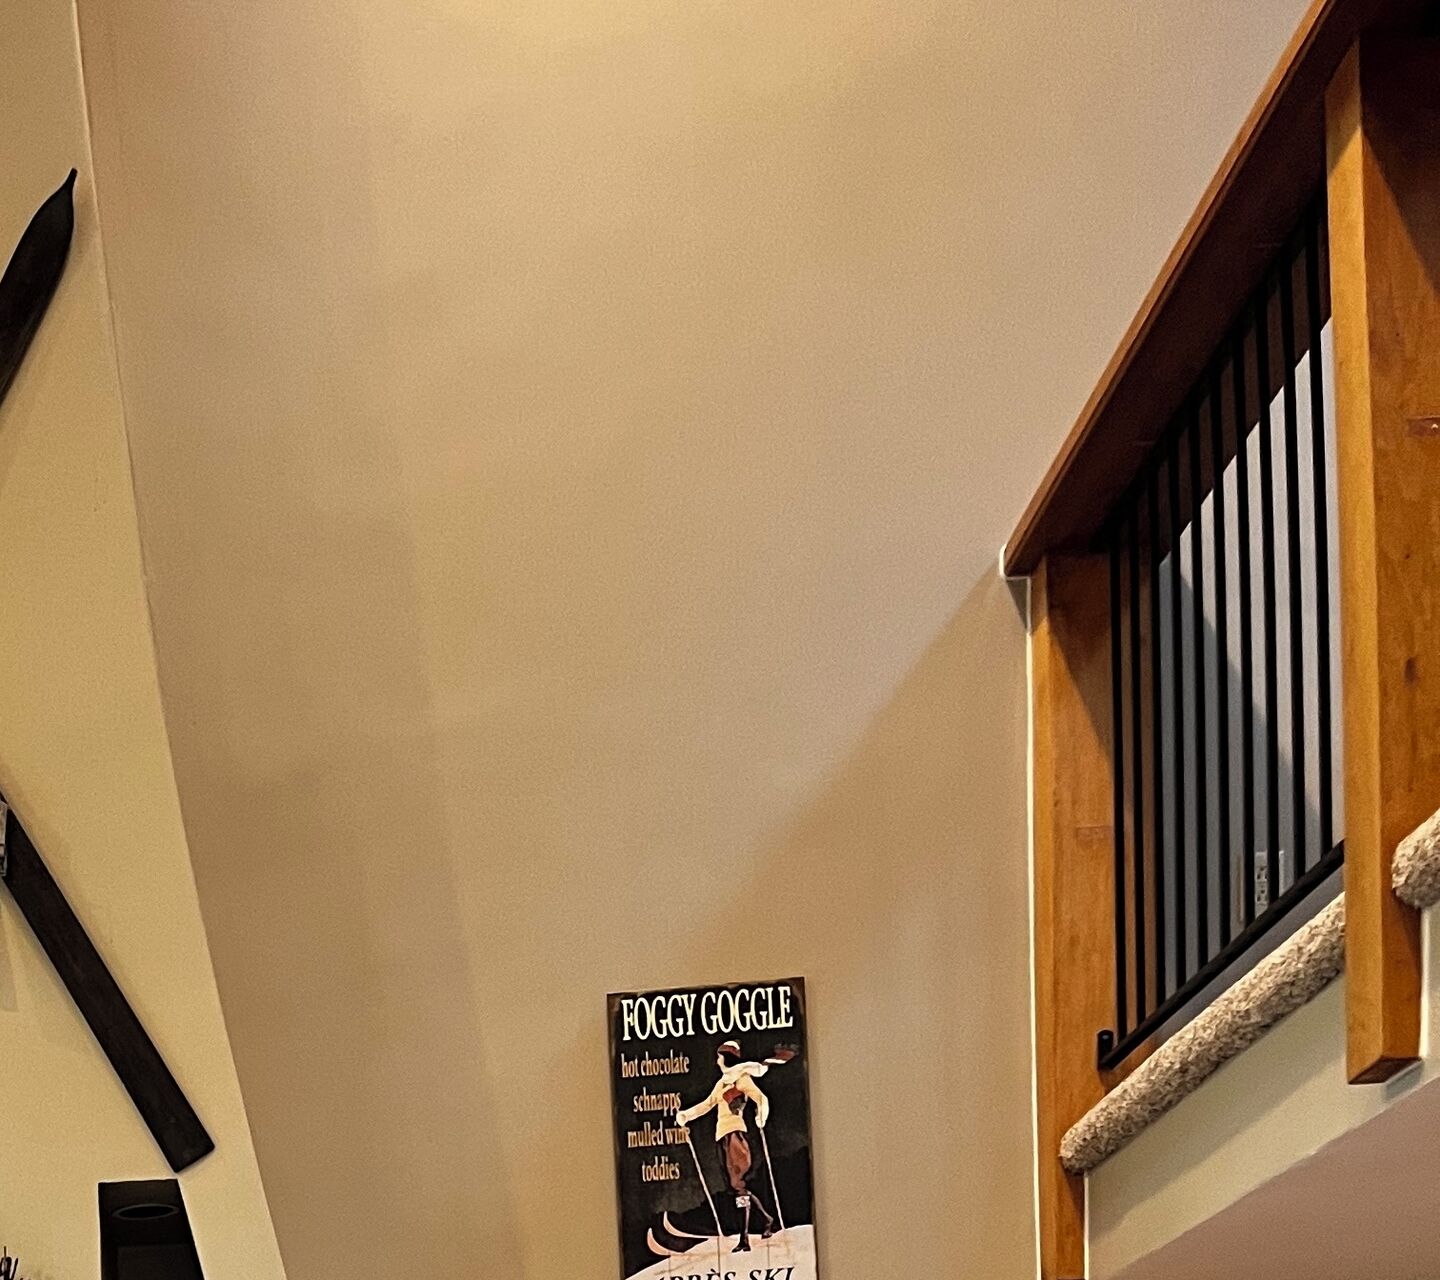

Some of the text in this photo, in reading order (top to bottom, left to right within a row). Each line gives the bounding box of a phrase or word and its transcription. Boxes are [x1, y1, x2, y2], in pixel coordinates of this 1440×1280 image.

[621, 986, 794, 1041] FOGGY GOGGLE
[621, 1049, 690, 1078] hot chocolate
[633, 1087, 682, 1117] schnapps
[627, 1122, 664, 1148] mulled
[642, 1156, 681, 1182] toddies
